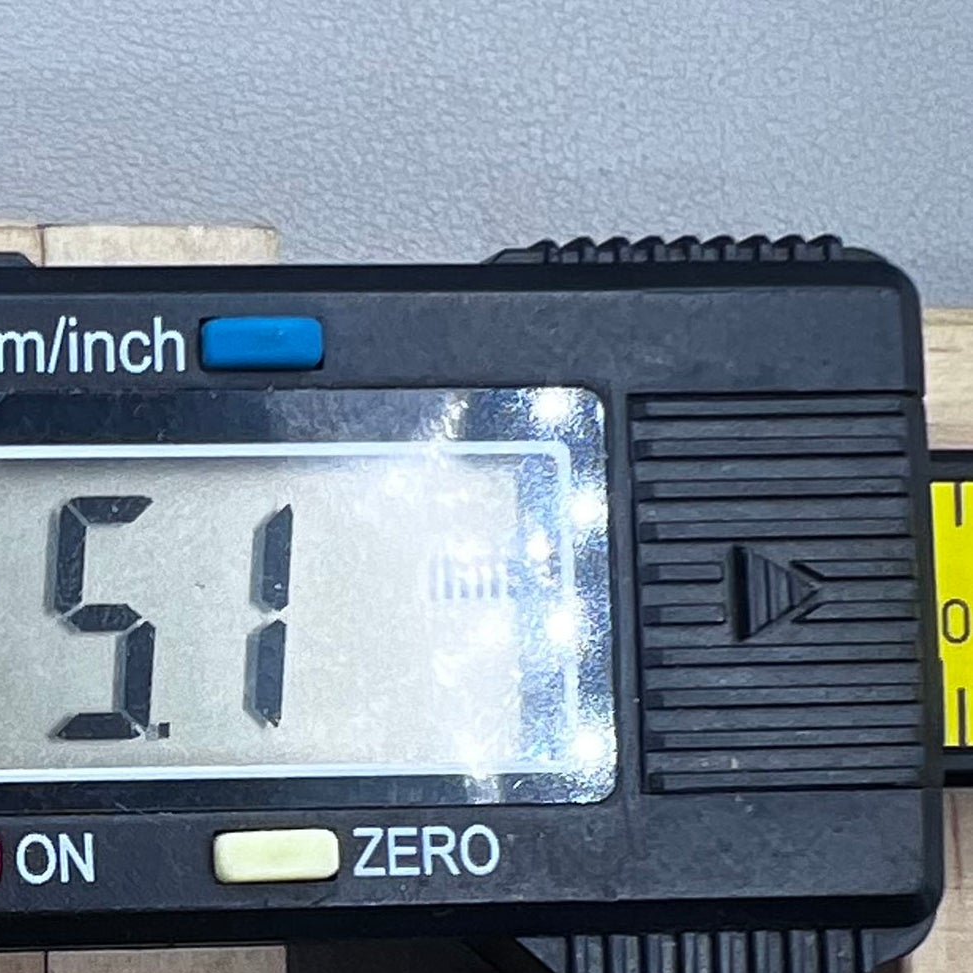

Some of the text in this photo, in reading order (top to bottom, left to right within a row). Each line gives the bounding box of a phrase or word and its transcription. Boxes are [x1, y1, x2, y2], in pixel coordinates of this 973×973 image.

[48, 495, 294, 740] 5.1
[942, 598, 970, 643] 0
[16, 833, 94, 883] ON
[353, 825, 500, 877] ZERO
